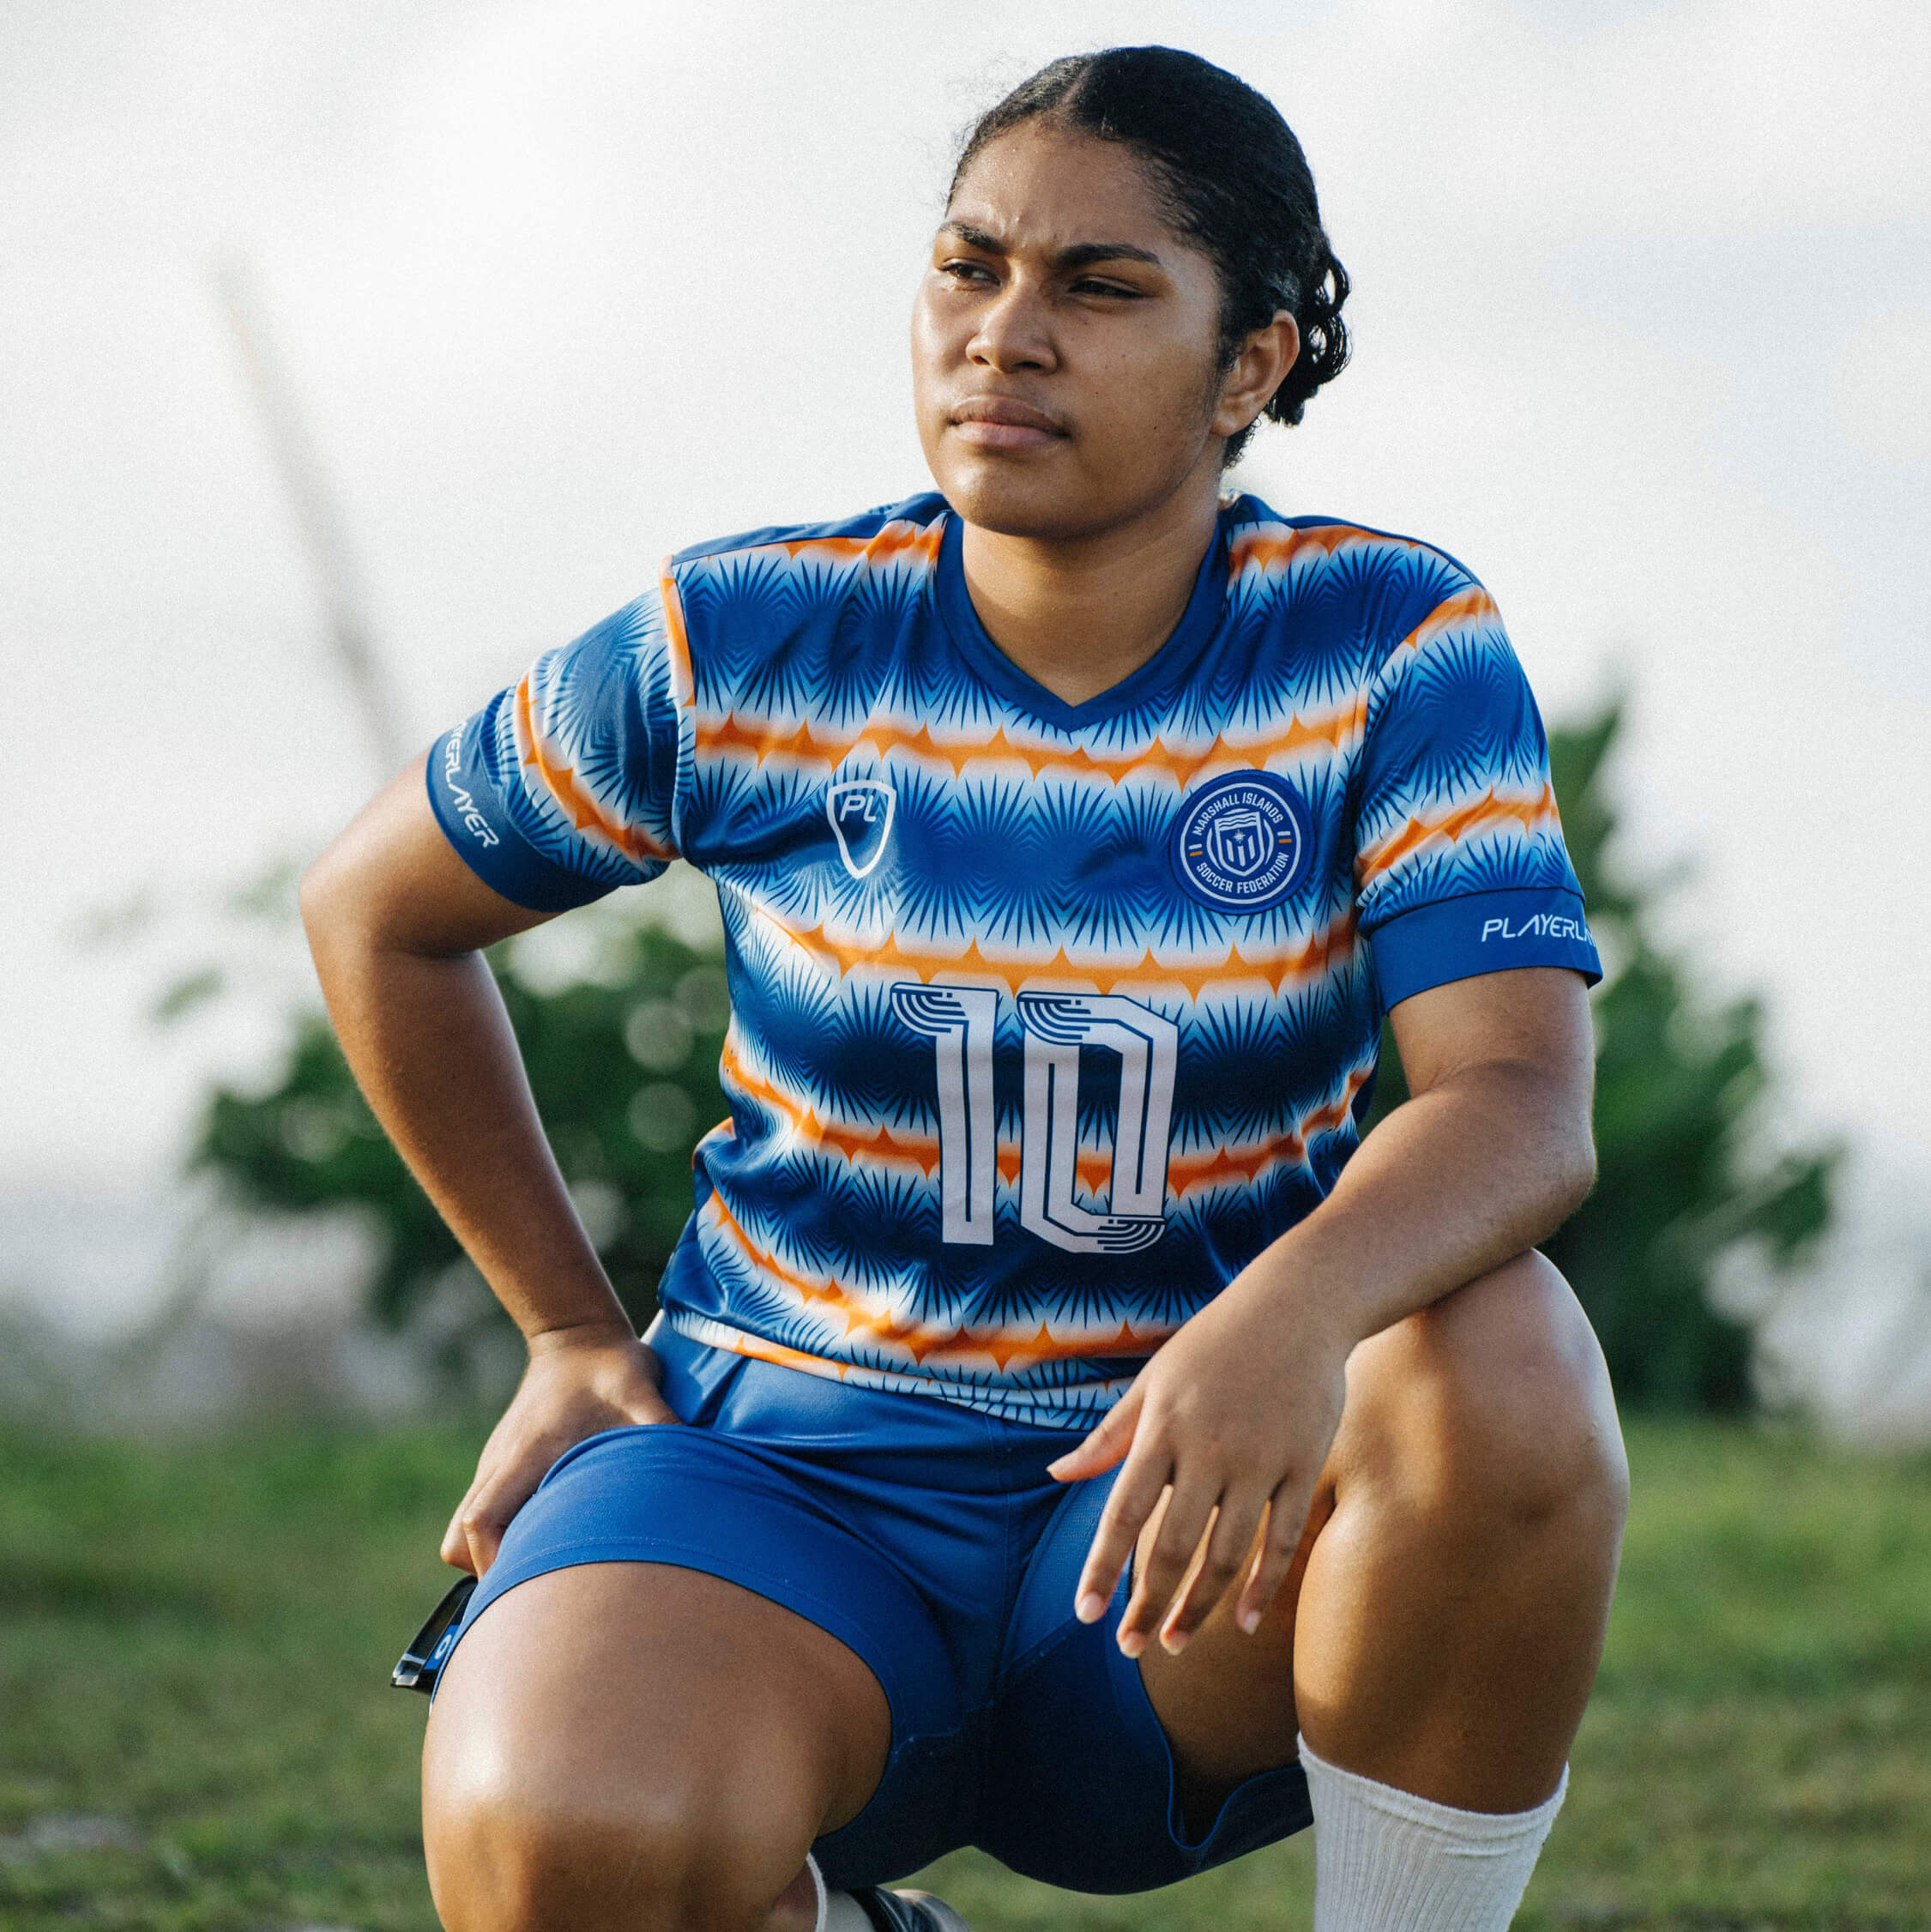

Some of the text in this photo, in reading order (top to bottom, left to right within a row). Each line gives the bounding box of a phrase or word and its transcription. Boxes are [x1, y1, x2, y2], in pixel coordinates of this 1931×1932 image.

[840, 794, 877, 822] PL
[1192, 792, 1284, 836] MARSHALL ISLANDS
[1196, 852, 1290, 894] SOCCER FEDERATION
[890, 981, 1180, 1254] 10
